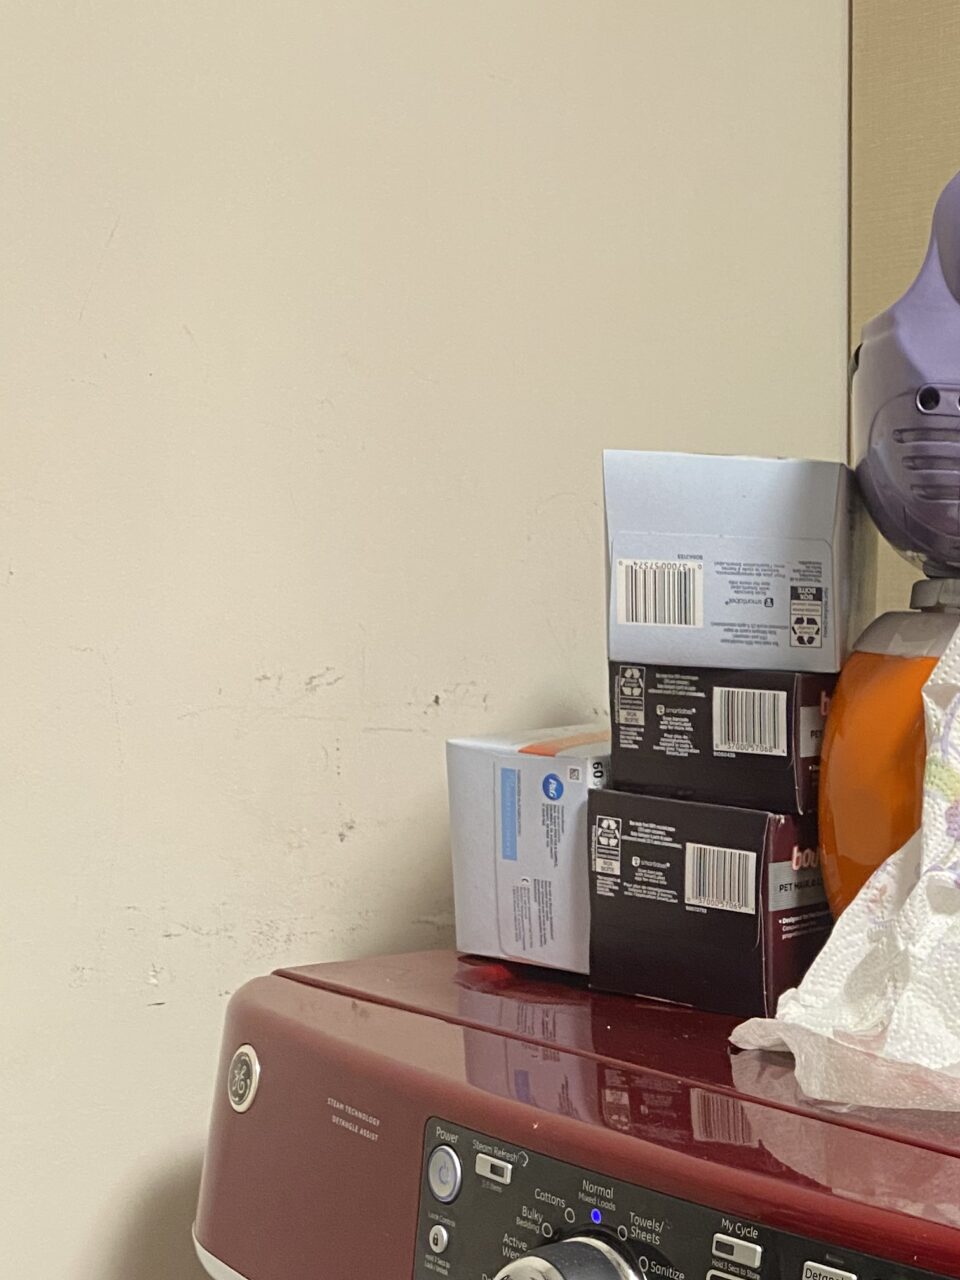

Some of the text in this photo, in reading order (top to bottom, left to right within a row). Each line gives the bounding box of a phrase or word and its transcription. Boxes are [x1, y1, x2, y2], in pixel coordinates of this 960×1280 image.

[779, 882, 792, 893] PET
[327, 1097, 381, 1128] STEAM TECHNOLOGY
[332, 1114, 379, 1142] DETANGLE ASSIST
[435, 1126, 459, 1144] Power
[472, 1139, 519, 1162] Steam Refresh
[534, 1187, 566, 1209] Cottons
[582, 1179, 615, 1200] Normal
[578, 1191, 616, 1212] Mixed Loads
[516, 1216, 540, 1234] Bedding
[522, 1205, 544, 1224] Bulky
[629, 1211, 665, 1233] Towels/
[630, 1226, 661, 1245] Sheets
[721, 1217, 759, 1239] My Cycle
[503, 1233, 528, 1251] Active
[712, 1258, 724, 1269] Hold
[740, 1266, 747, 1275] to
